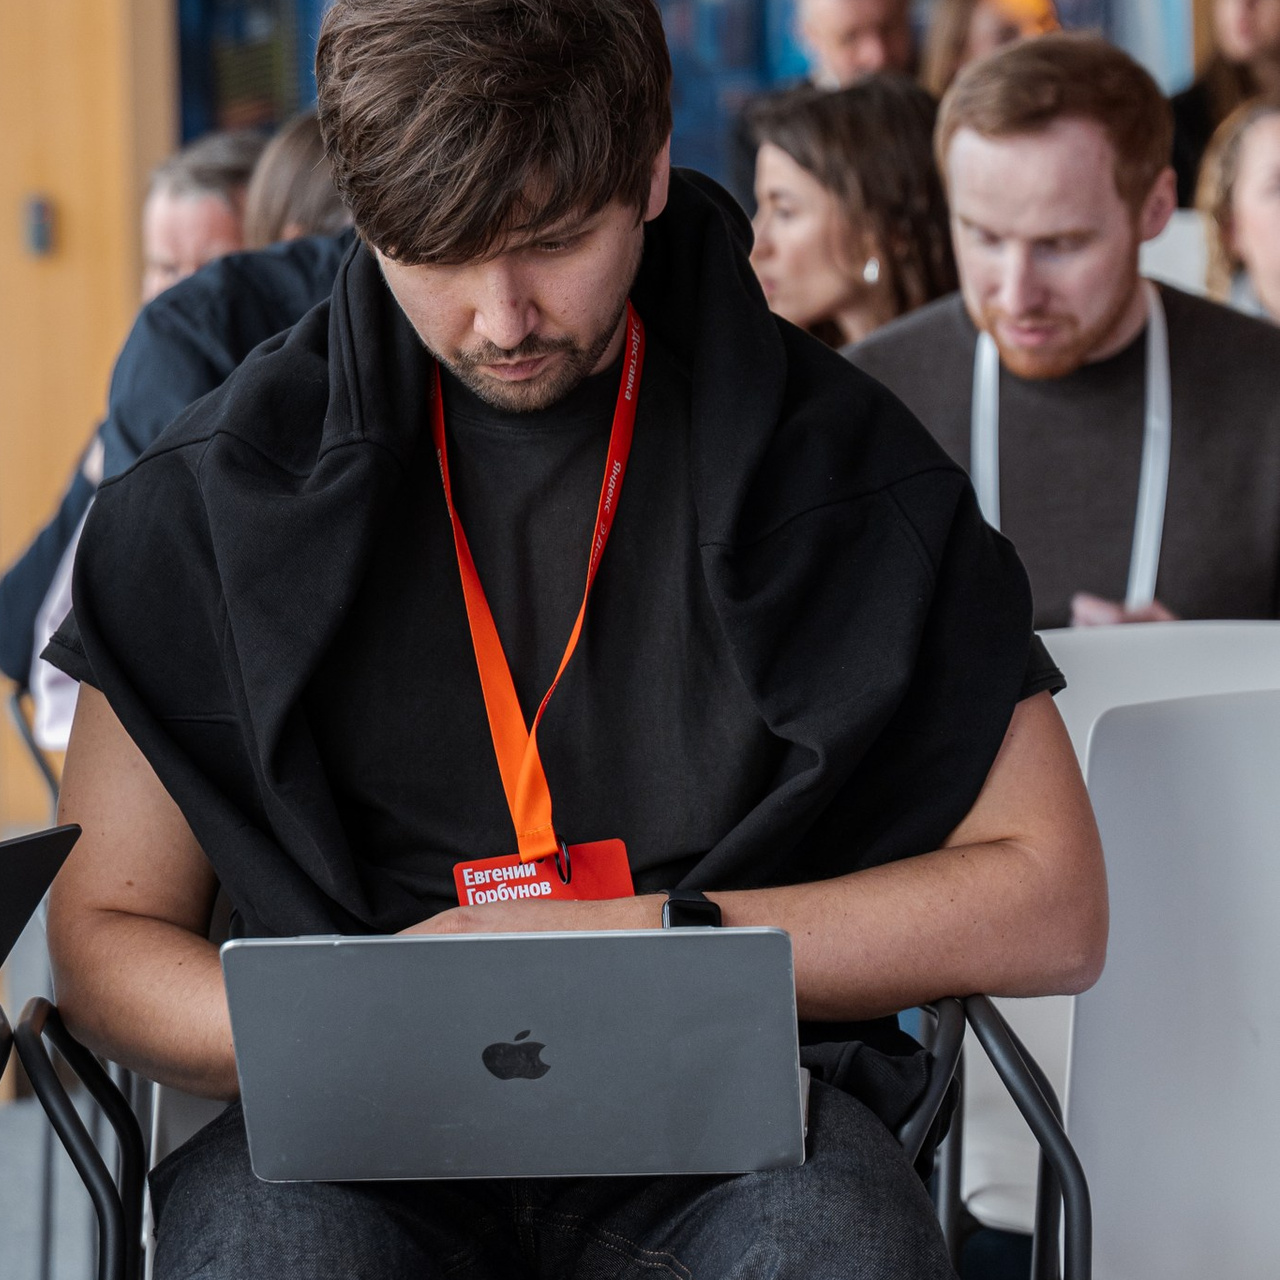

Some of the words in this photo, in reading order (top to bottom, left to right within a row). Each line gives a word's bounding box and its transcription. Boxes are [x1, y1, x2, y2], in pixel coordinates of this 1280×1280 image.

[624, 328, 641, 401] Доставка
[604, 460, 621, 514] Яндекс
[466, 881, 552, 906] Горбунов
